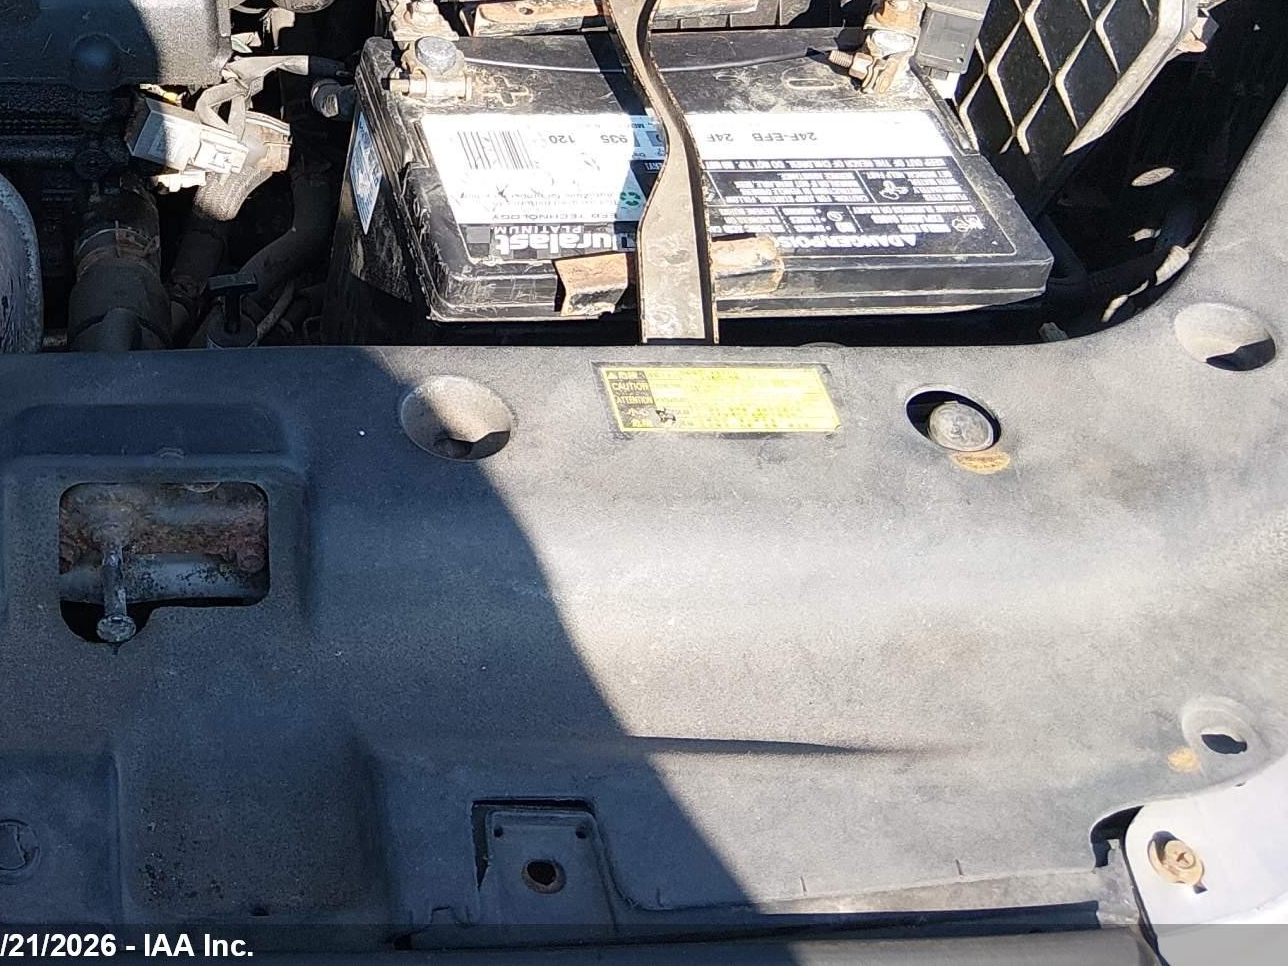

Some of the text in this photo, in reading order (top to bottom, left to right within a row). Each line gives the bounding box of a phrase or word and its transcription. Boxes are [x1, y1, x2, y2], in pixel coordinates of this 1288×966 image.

[548, 135, 575, 144] 120
[752, 132, 817, 142] 24F-EFB
[494, 232, 638, 255] Duralast
[611, 381, 650, 392] CAUTION
